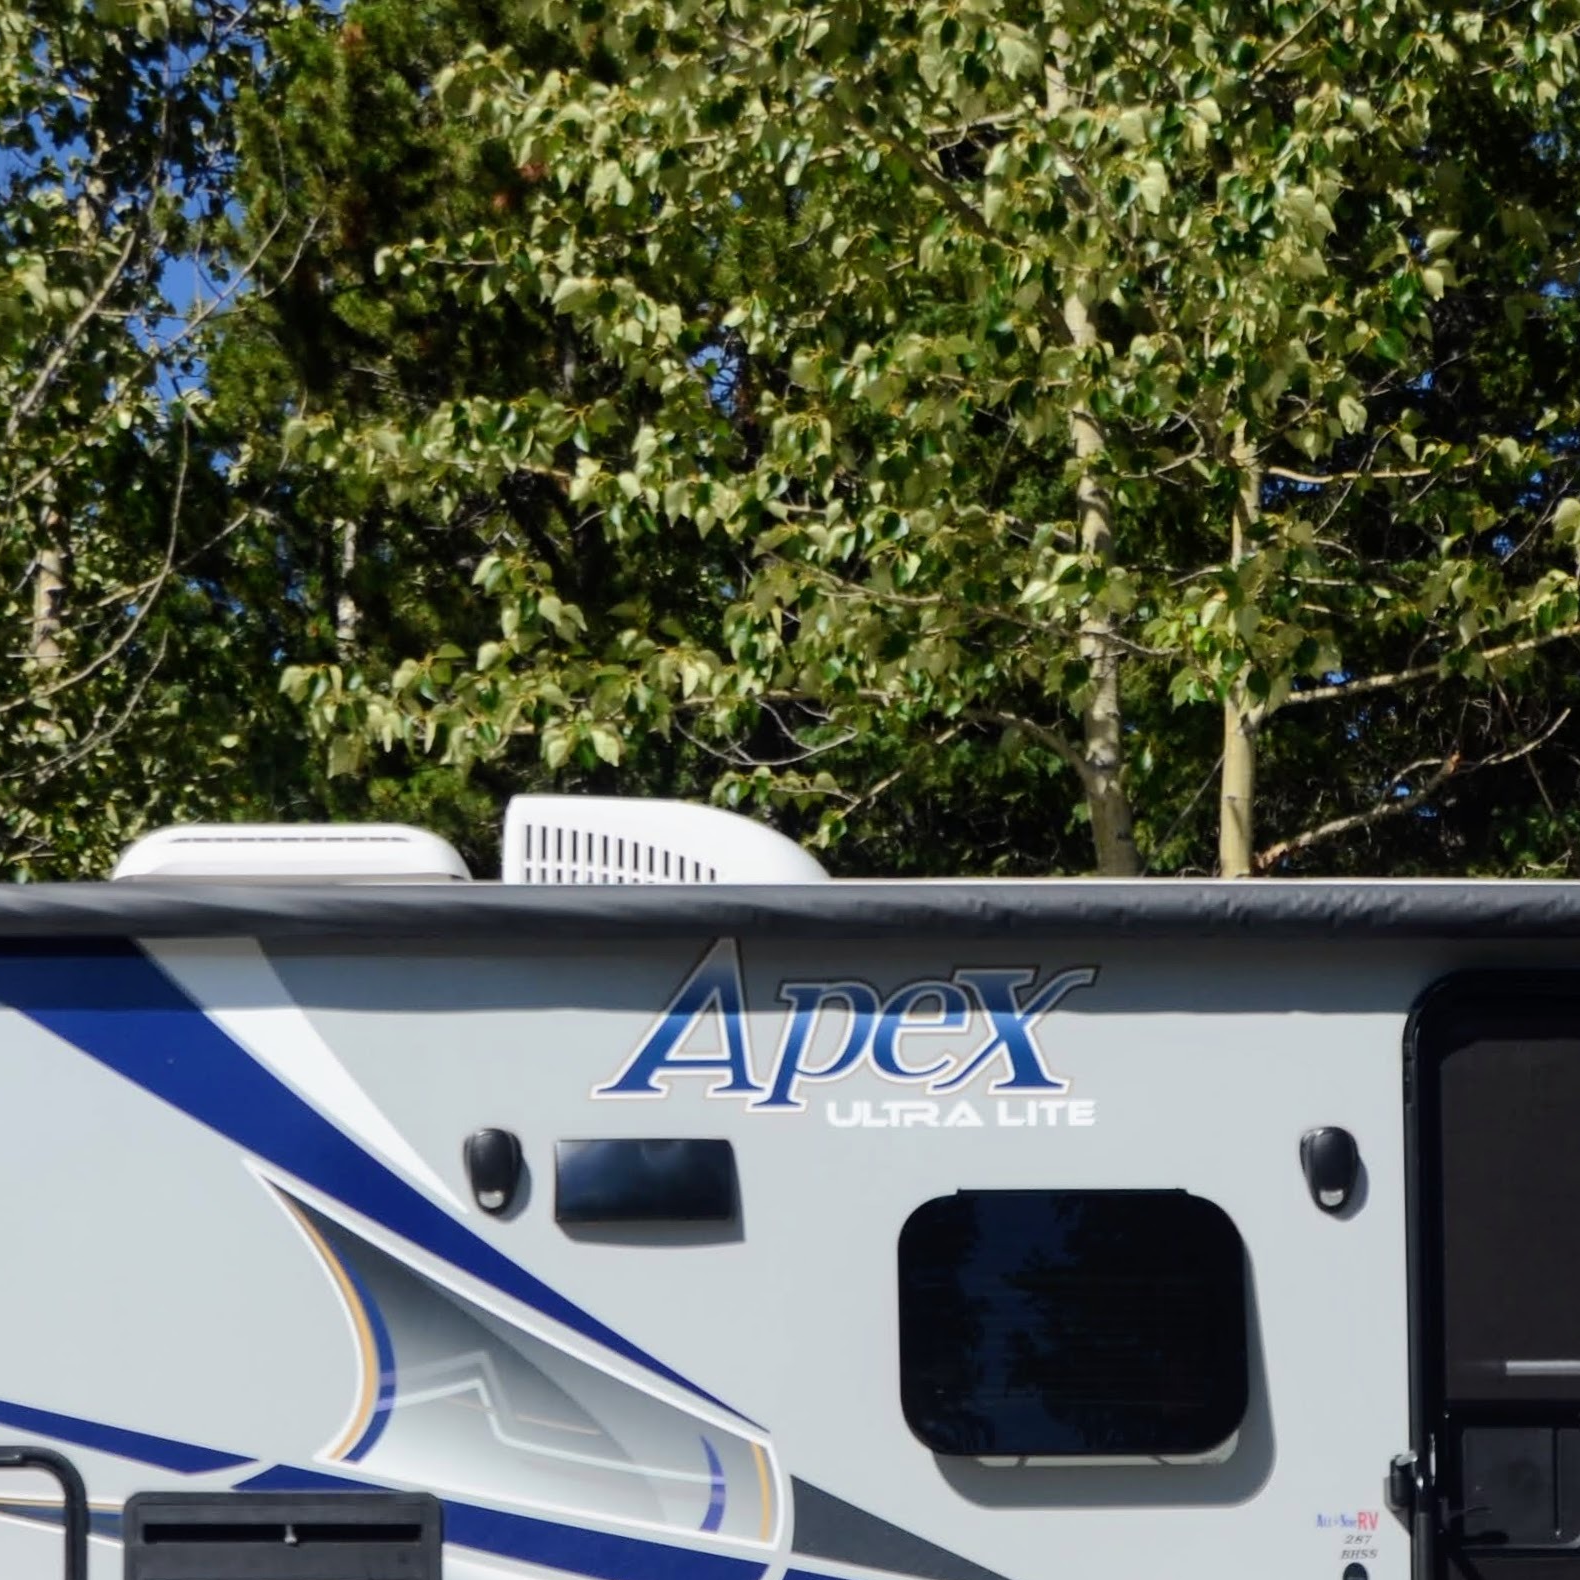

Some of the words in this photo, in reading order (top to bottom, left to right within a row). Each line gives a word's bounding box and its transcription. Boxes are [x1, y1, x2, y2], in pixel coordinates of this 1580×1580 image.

[826, 1099, 984, 1128] ULTRA
[998, 1099, 1096, 1128] LITE
[1344, 1534, 1373, 1545] 287
[1340, 1549, 1378, 1560] BHSS
